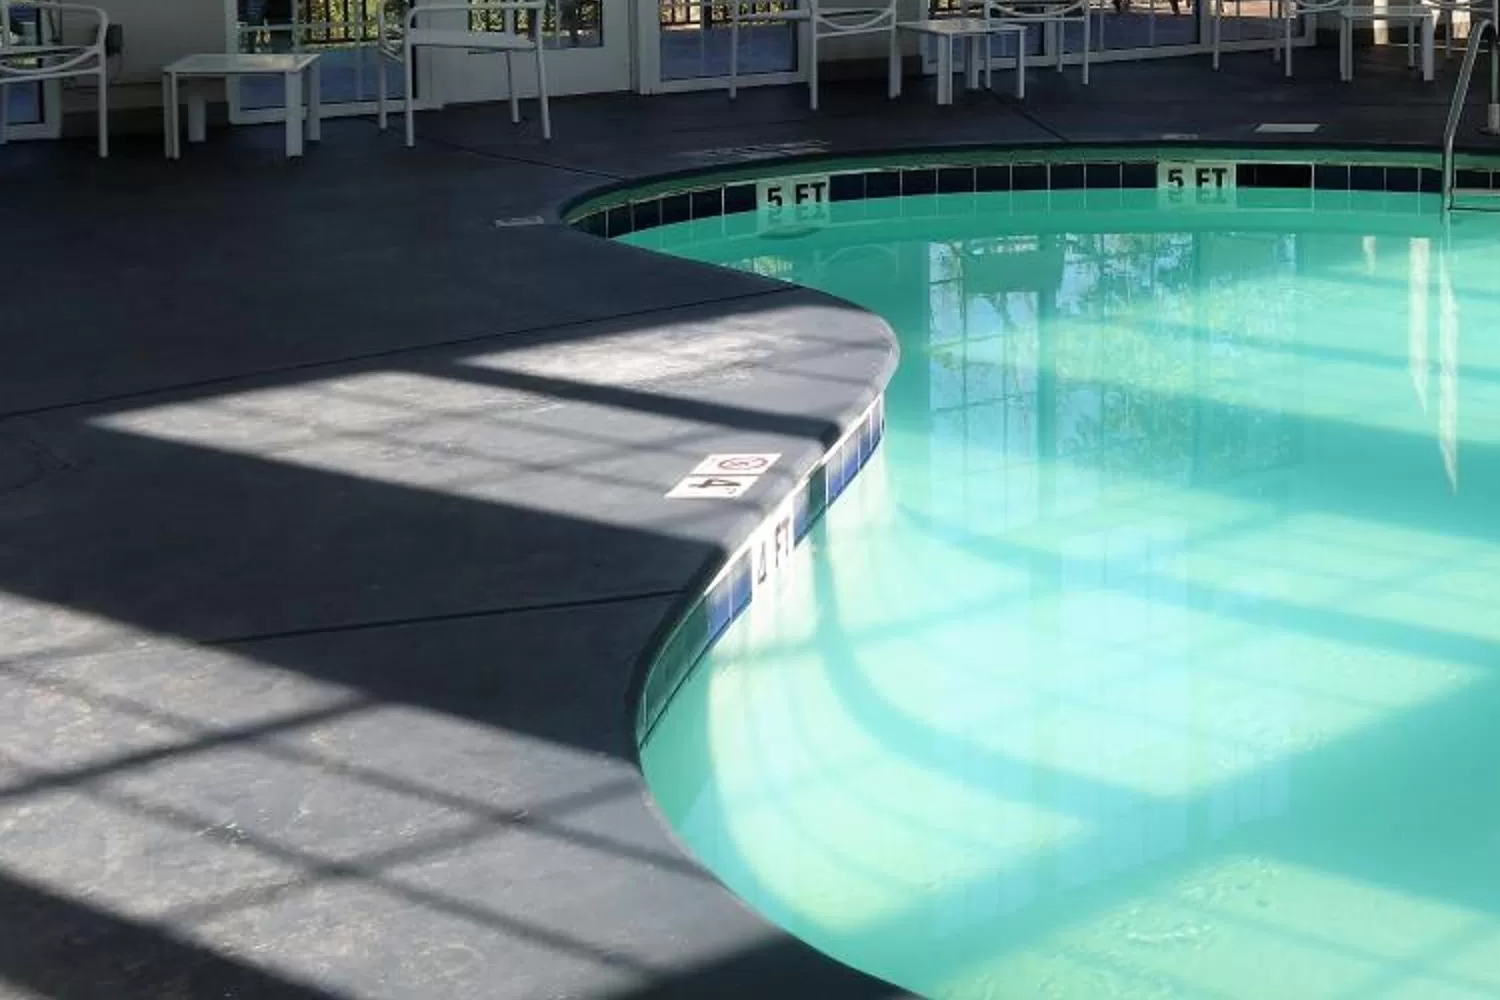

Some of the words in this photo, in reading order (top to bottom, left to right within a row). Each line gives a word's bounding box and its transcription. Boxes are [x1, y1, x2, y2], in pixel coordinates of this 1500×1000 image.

[1167, 168, 1184, 187] 5
[1196, 168, 1227, 187] FT
[767, 186, 783, 207] 5
[795, 182, 827, 204] FT
[775, 516, 790, 568] FT
